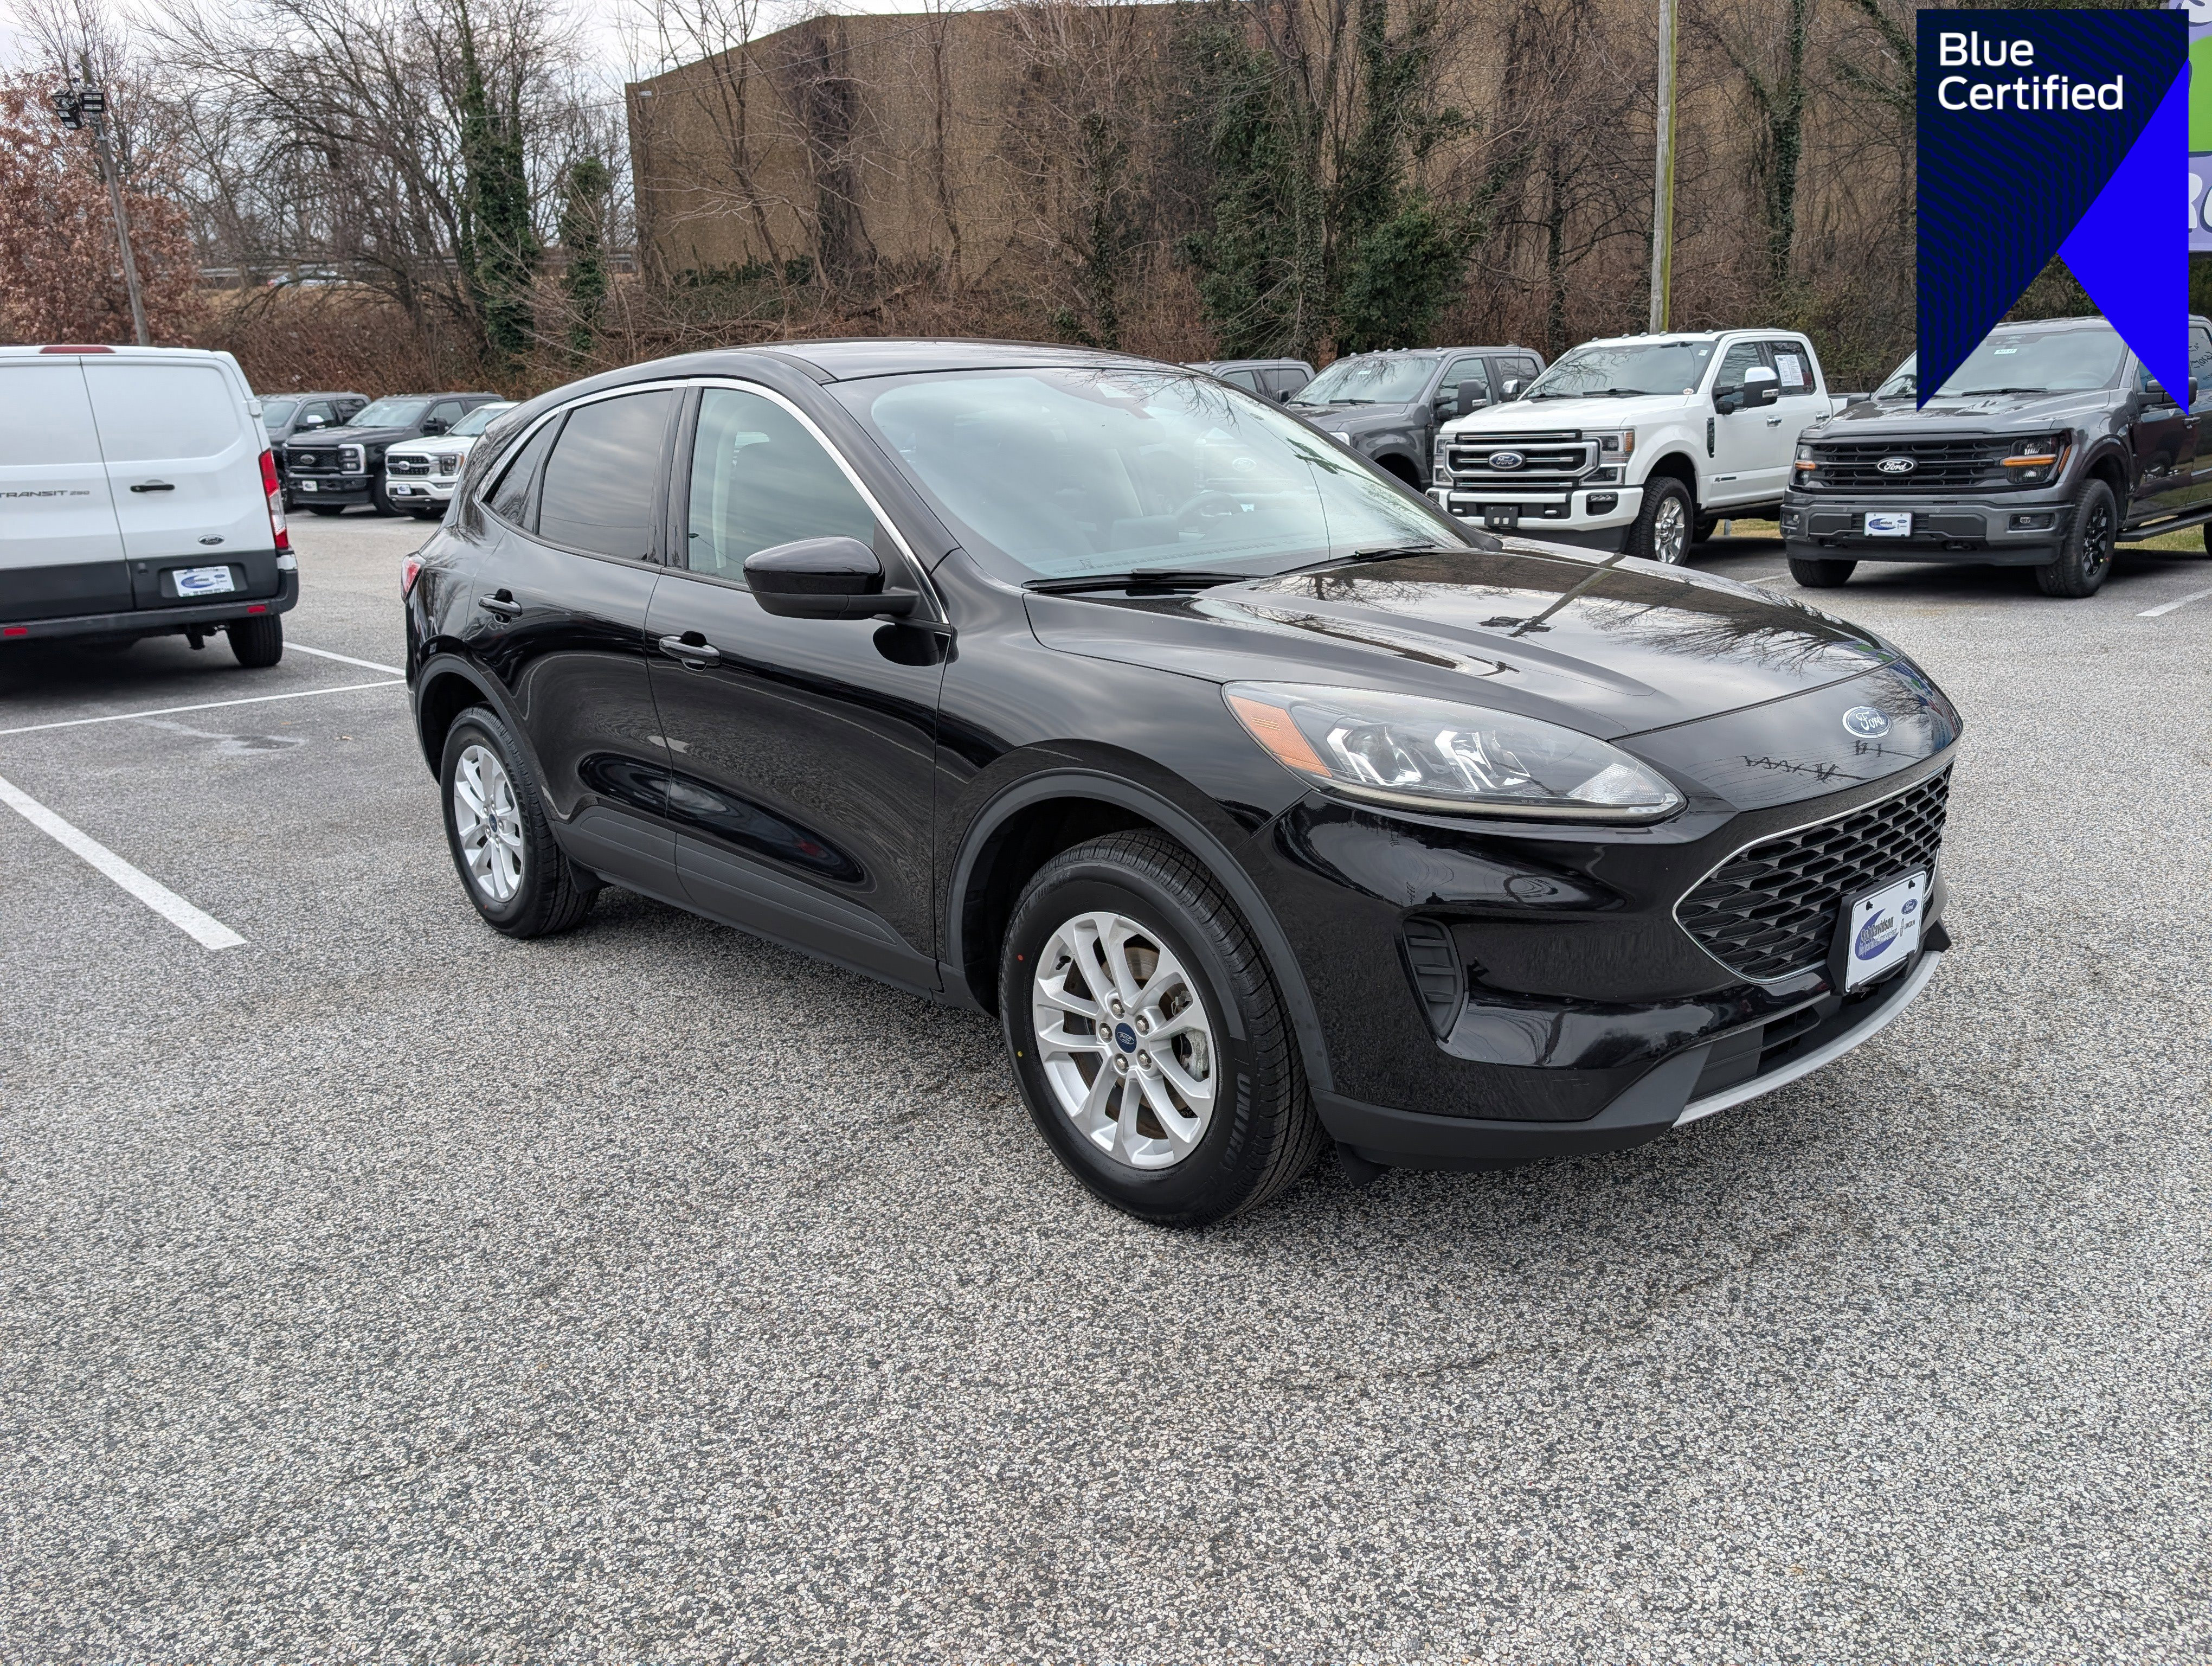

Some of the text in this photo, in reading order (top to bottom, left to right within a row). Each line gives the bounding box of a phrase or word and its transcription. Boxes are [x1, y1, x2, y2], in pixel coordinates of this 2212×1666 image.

[1495, 456, 1514, 465] Ford
[1883, 460, 1907, 471] Ford
[0, 490, 68, 498] TRANSIT
[1855, 710, 1885, 731] Ford
[1860, 926, 1872, 945] Bob
[1870, 916, 1894, 939] Davidson
[1119, 1033, 1131, 1044] Ford
